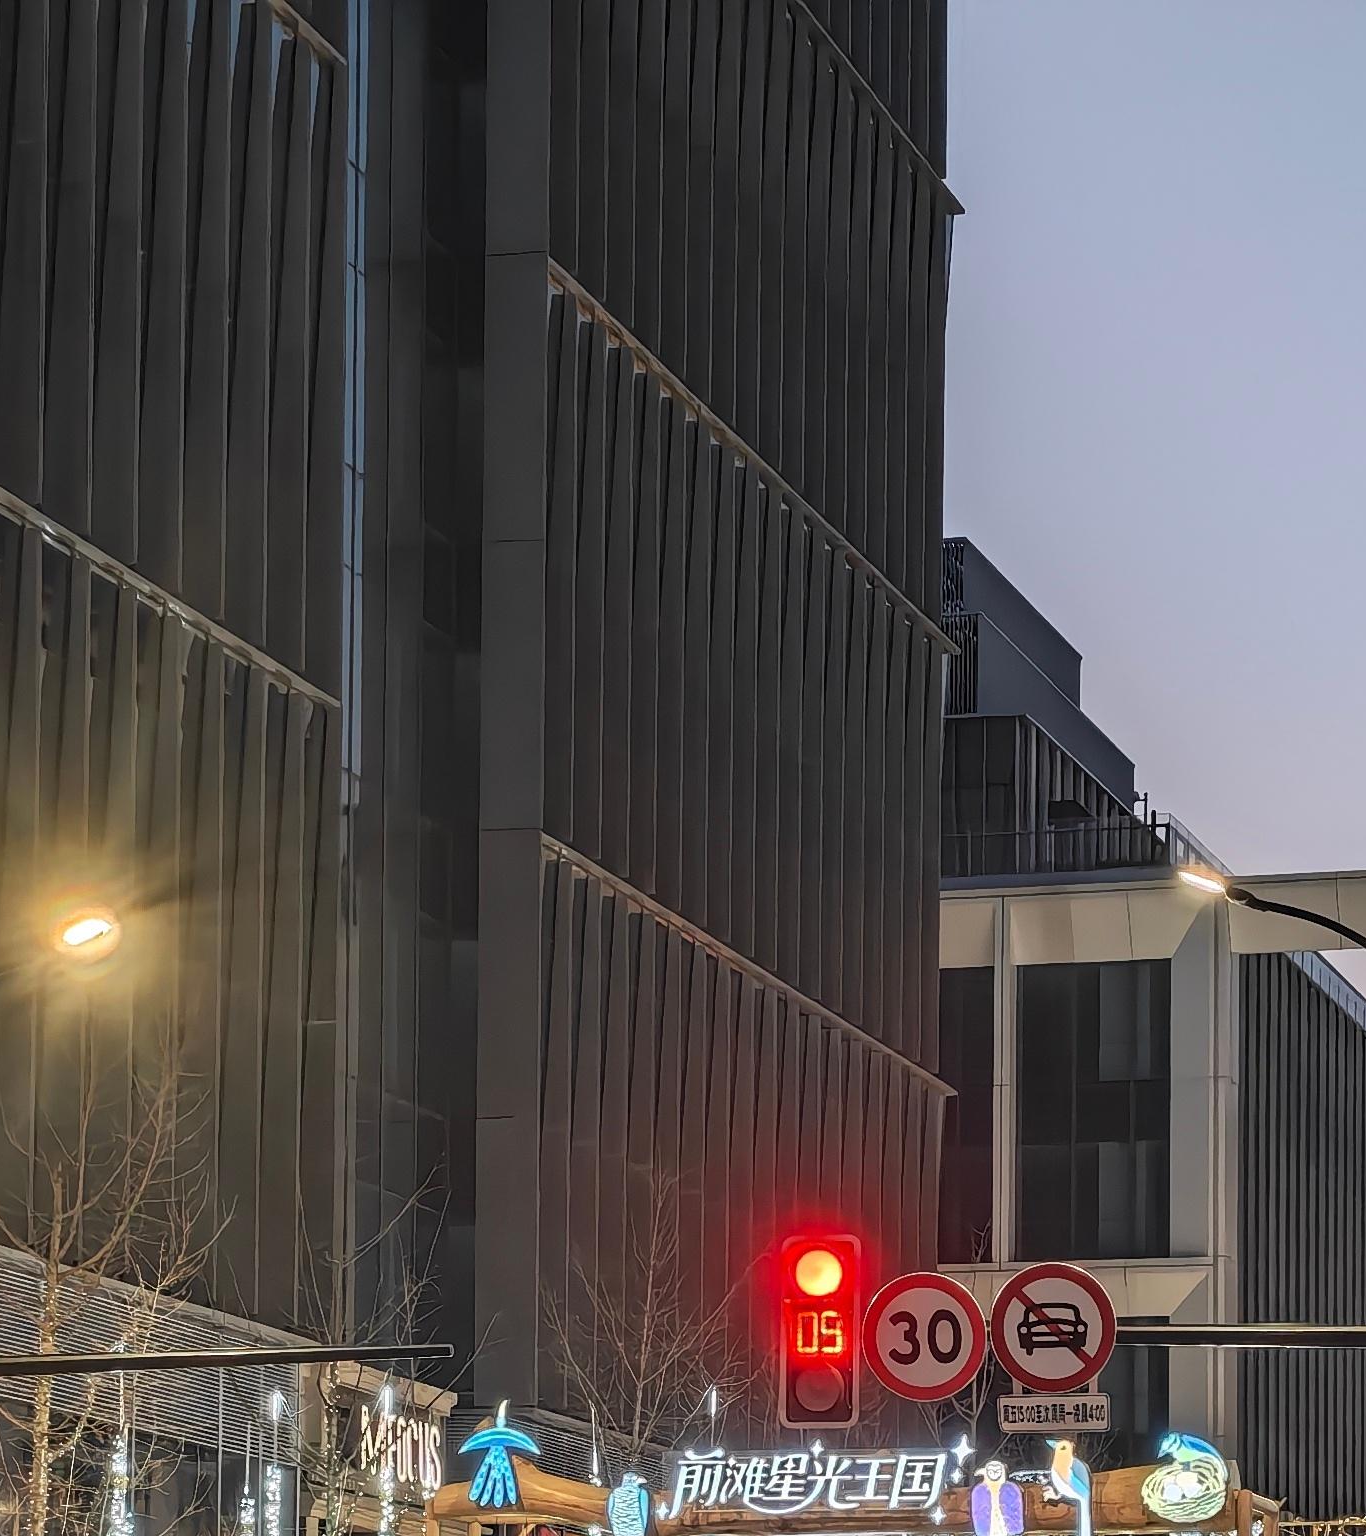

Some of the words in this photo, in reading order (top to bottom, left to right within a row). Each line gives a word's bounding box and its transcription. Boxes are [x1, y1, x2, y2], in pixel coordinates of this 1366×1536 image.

[888, 1308, 962, 1366] 30
[668, 1447, 948, 1519] 前滩星光王国
